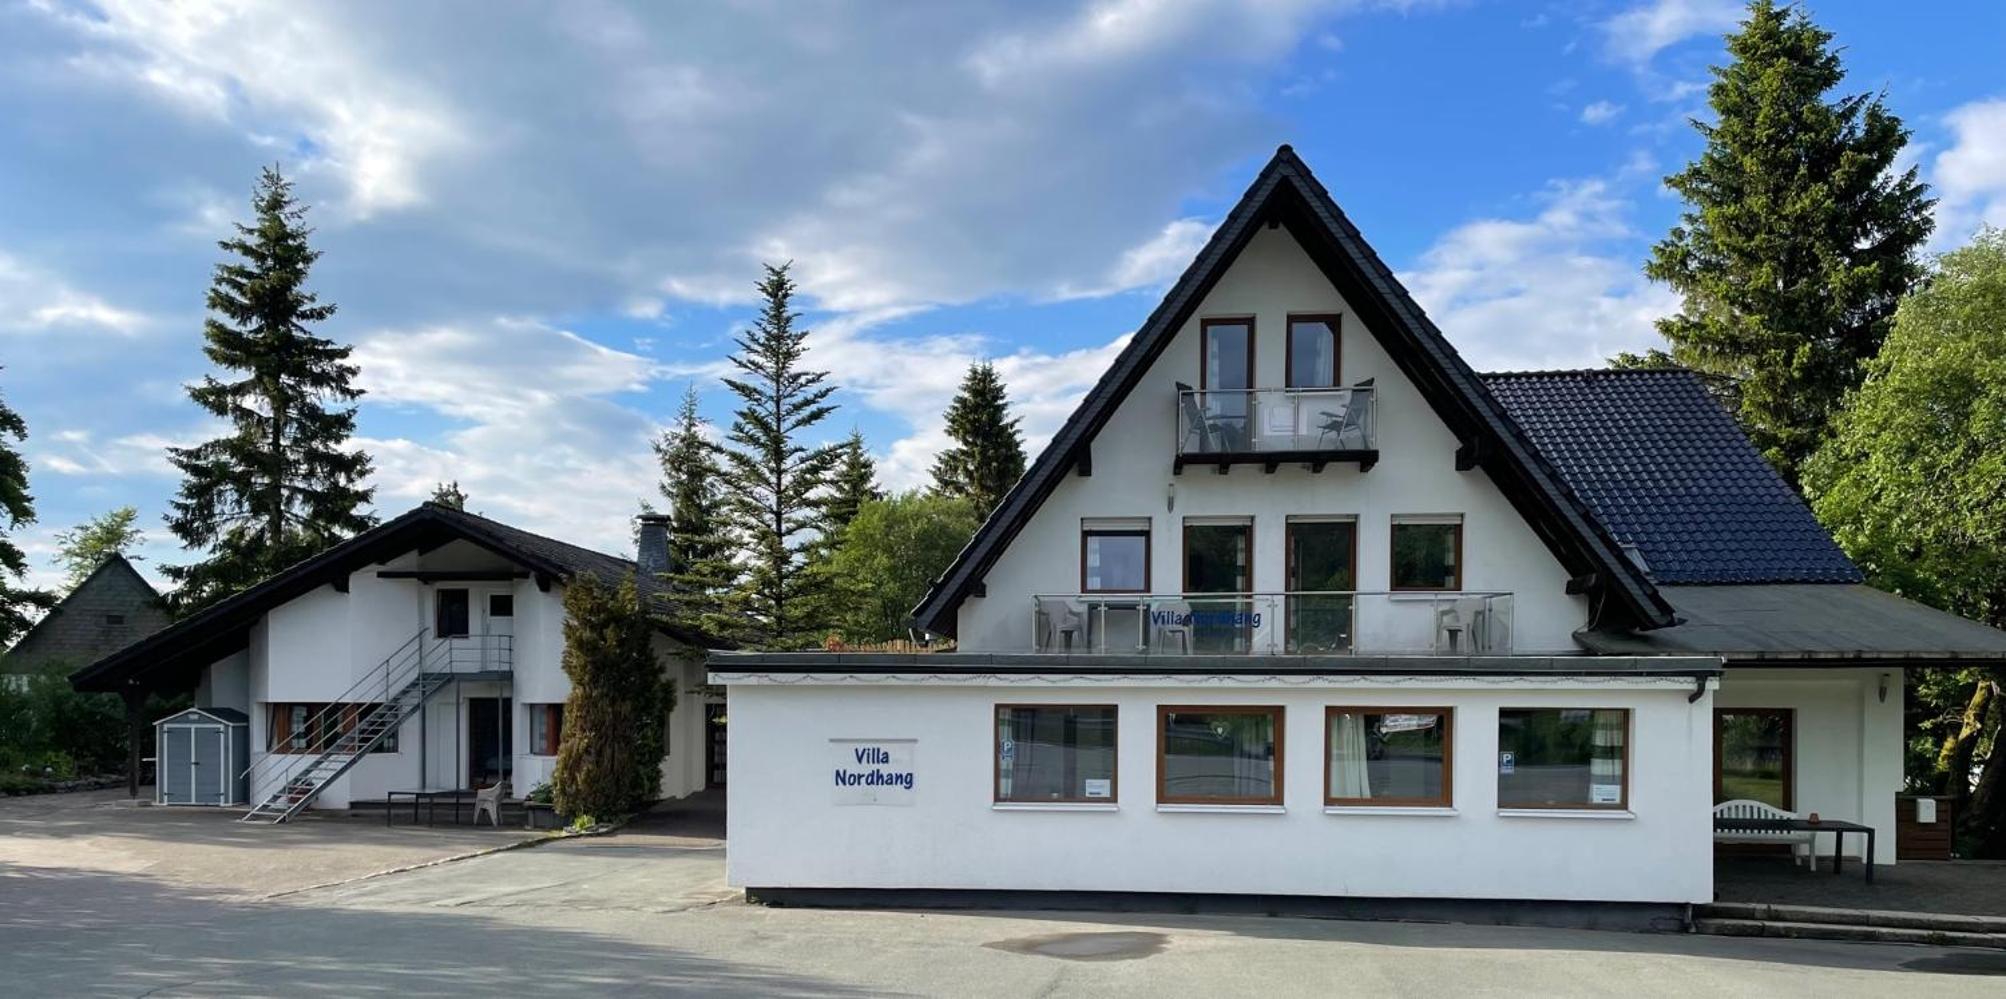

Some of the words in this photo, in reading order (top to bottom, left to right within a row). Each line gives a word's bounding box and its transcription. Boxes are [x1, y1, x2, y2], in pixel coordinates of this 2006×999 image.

[1151, 610, 1182, 626] Villa
[855, 747, 890, 765] Villa
[835, 769, 914, 790] Nordhang
